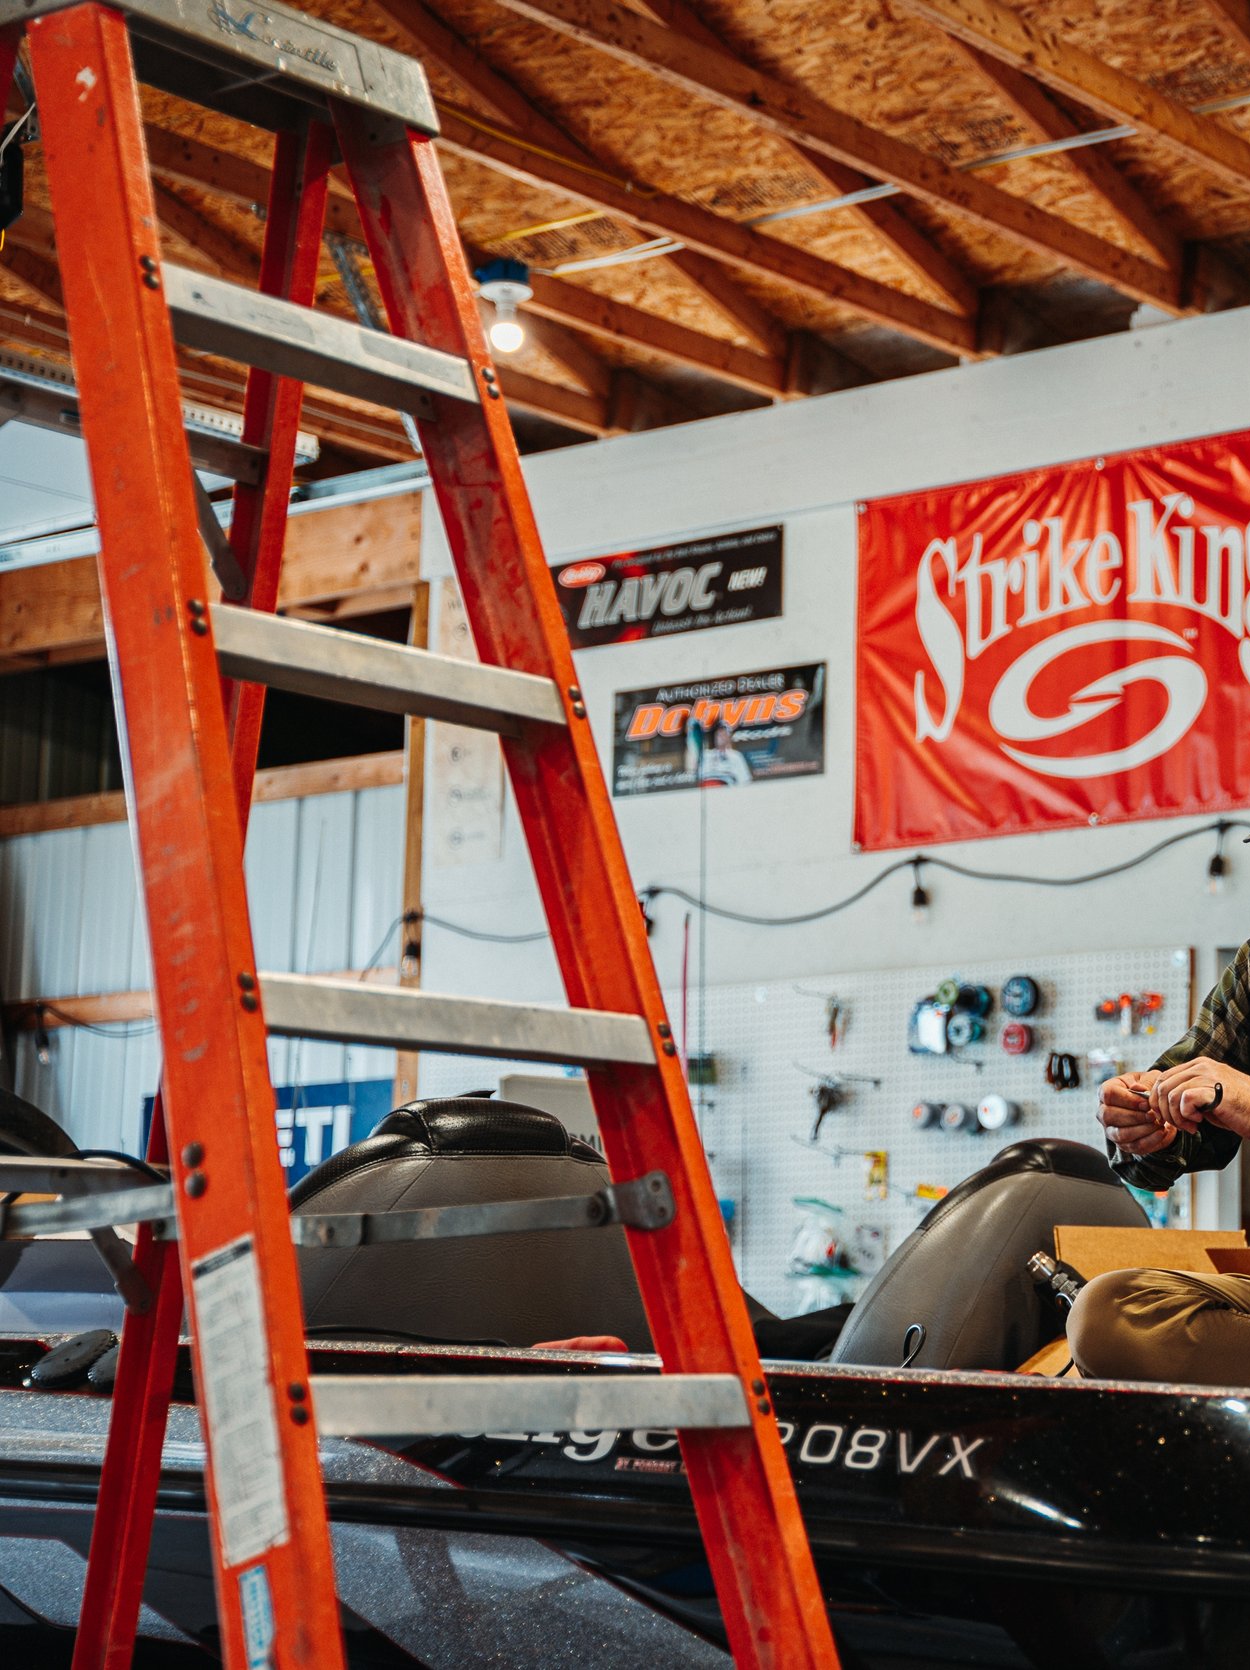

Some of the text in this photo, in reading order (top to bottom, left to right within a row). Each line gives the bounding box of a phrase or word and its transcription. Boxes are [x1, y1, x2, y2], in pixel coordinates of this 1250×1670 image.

[577, 561, 724, 630] HAVOC
[727, 566, 768, 592] NEW!
[915, 516, 1124, 743] Strike
[656, 680, 737, 703] AUTHORIZED
[275, 1104, 350, 1168] ETI
